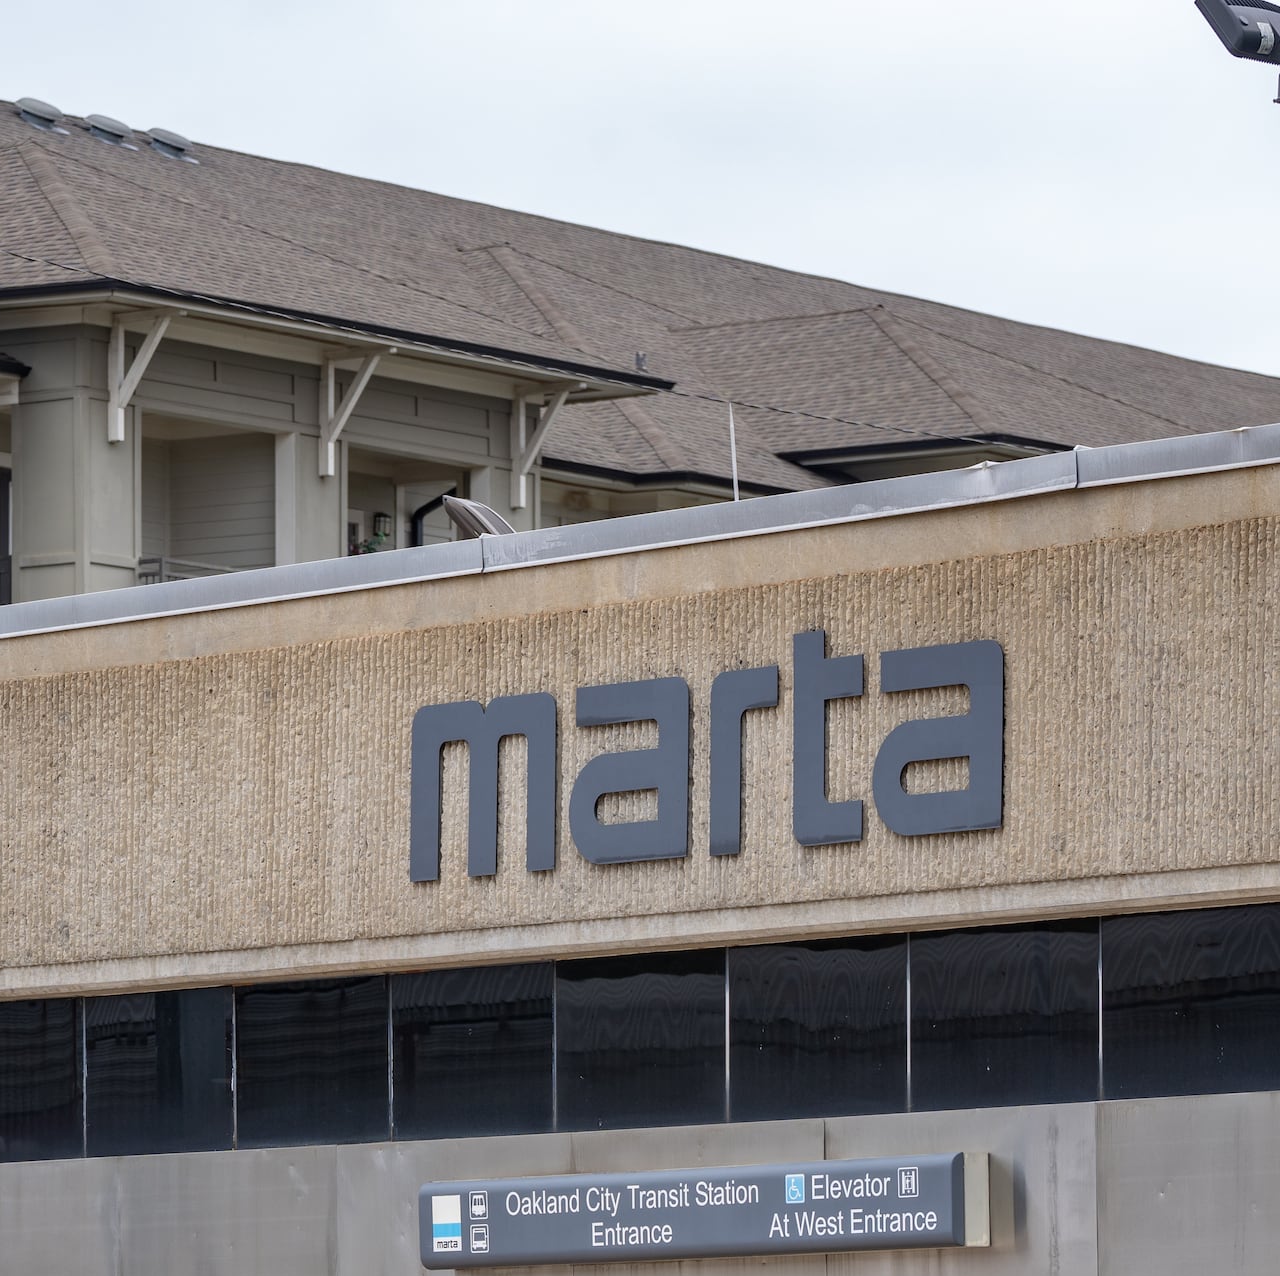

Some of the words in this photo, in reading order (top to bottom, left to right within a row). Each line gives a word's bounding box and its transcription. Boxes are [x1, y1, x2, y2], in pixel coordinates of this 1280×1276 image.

[410, 630, 1004, 883] marta
[505, 1189, 580, 1217] Oakland
[585, 1186, 621, 1217] City
[627, 1183, 690, 1210] Transit
[695, 1179, 760, 1207] Station
[811, 1173, 891, 1200] Elevator
[591, 1221, 673, 1248] Entrance
[769, 1213, 790, 1239] At
[794, 1210, 845, 1237] West
[850, 1207, 938, 1234] Entrance
[436, 1238, 459, 1250] marta
